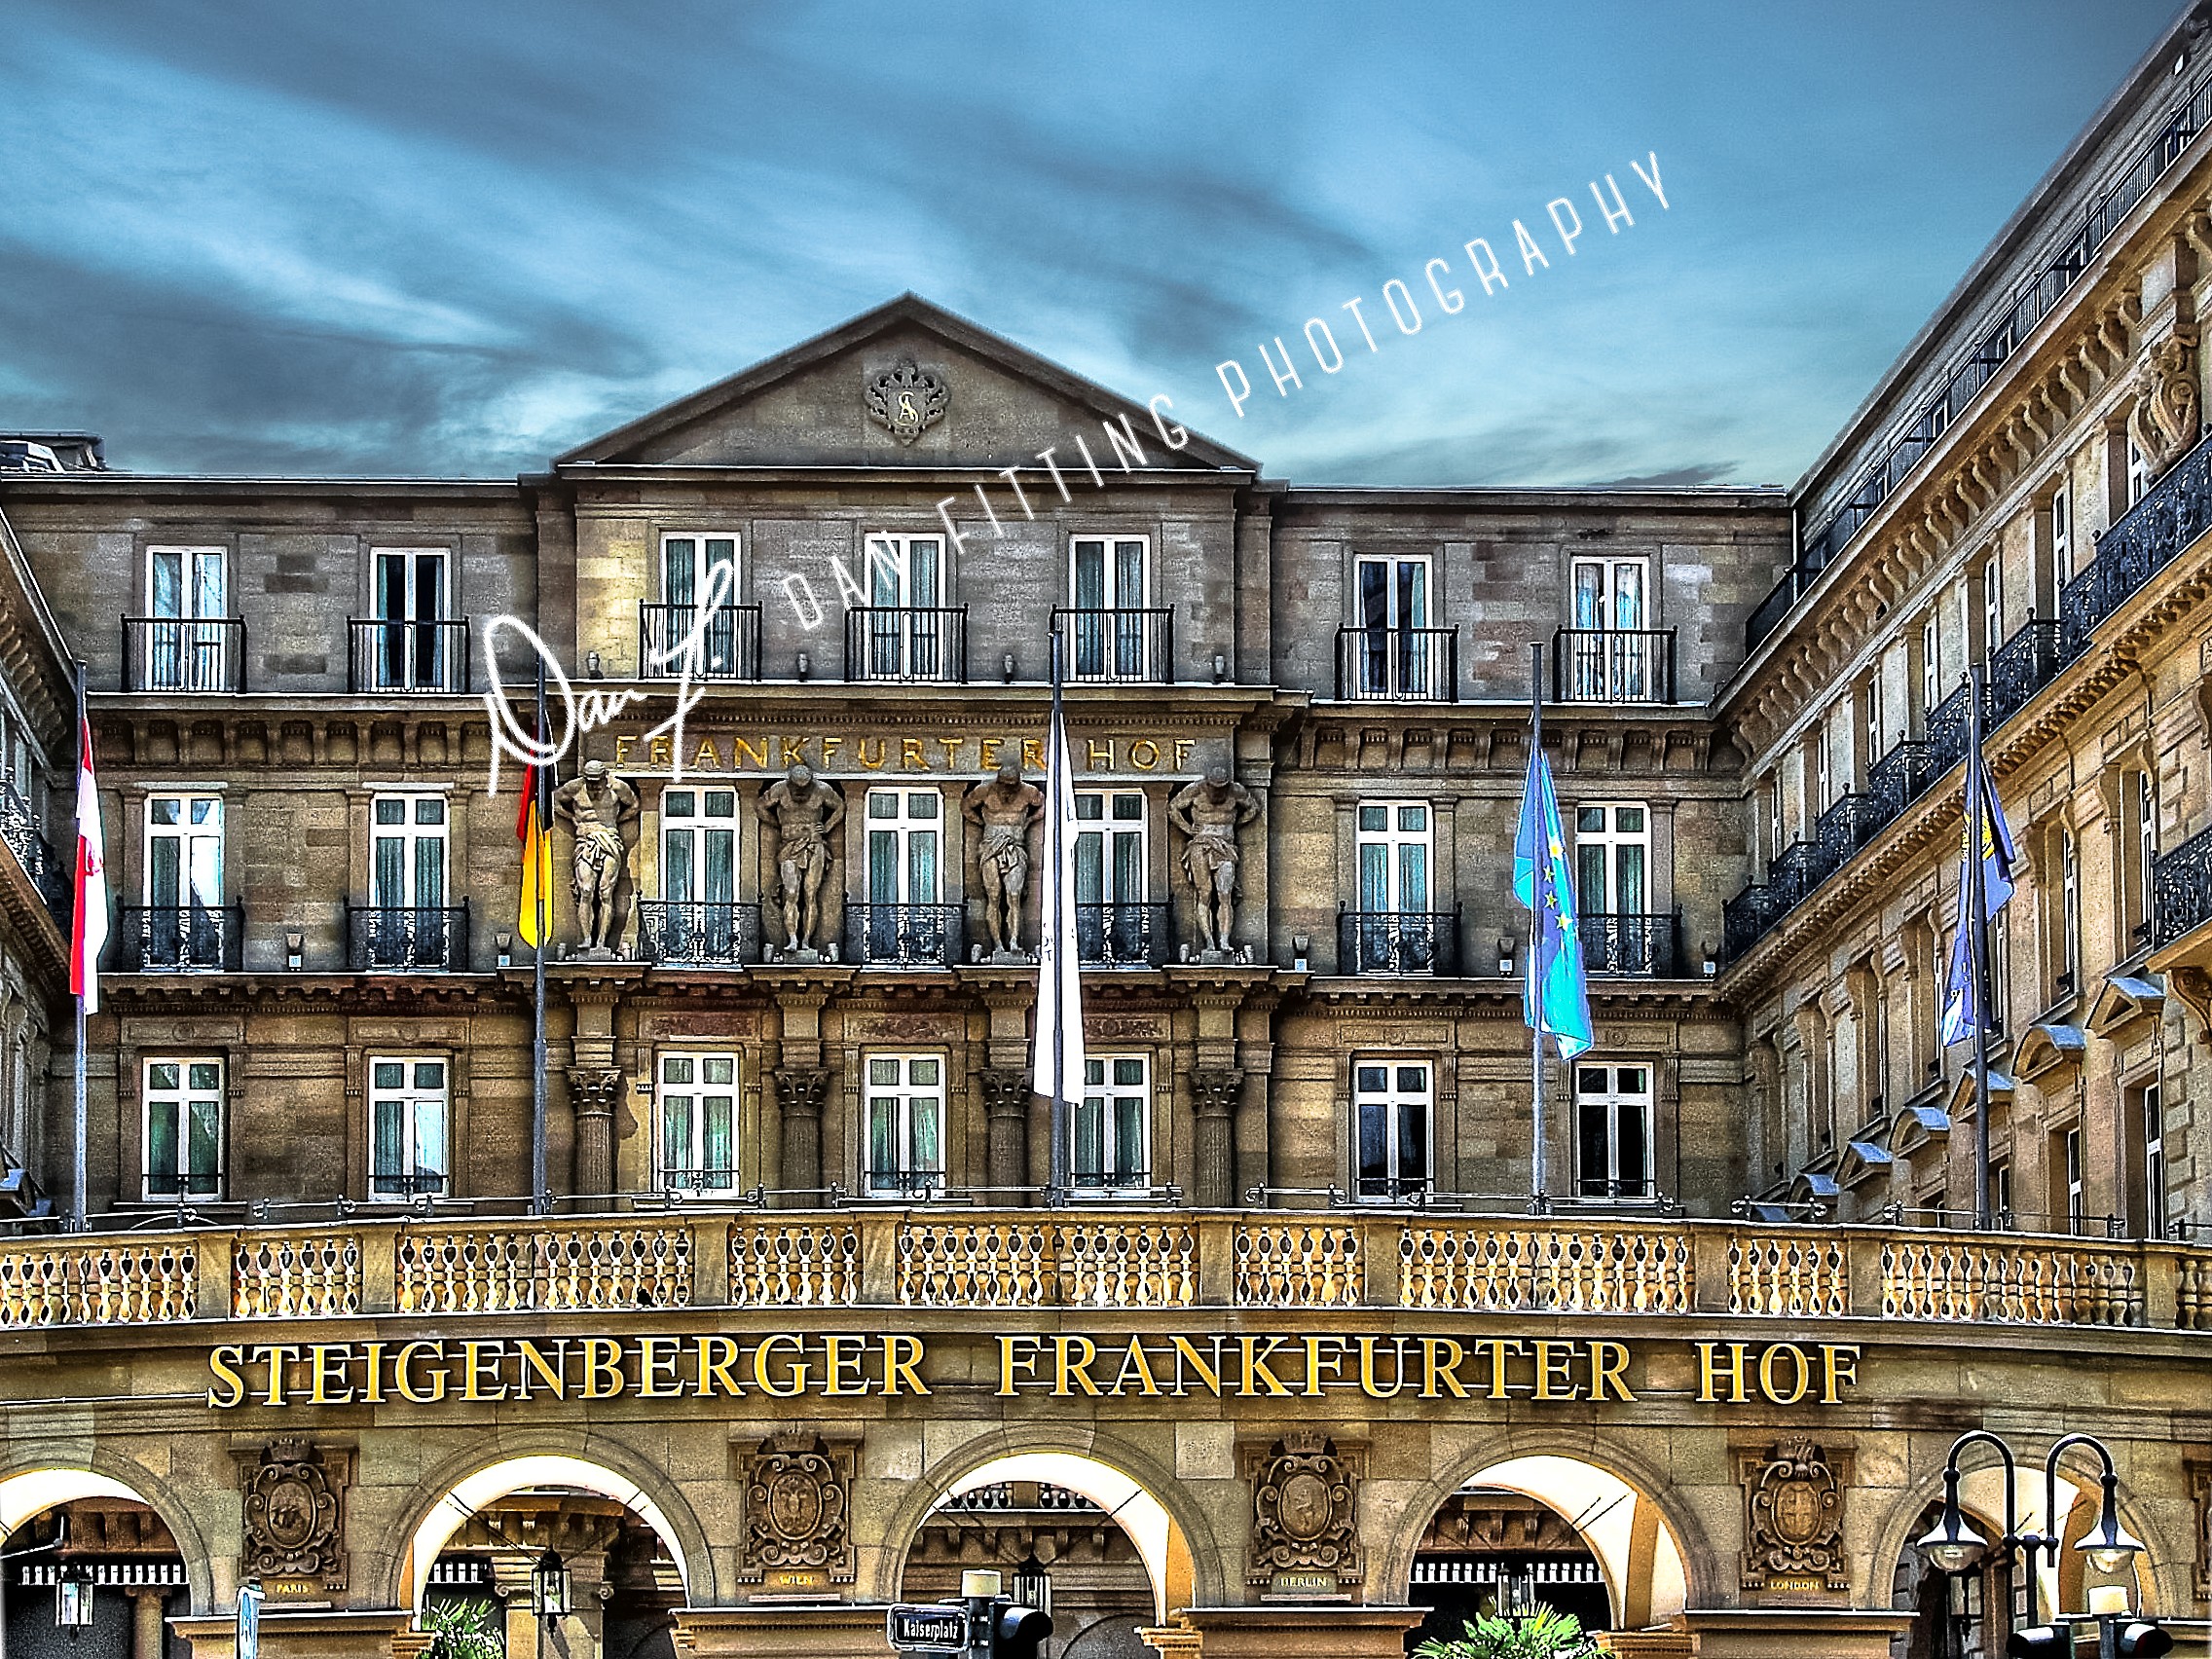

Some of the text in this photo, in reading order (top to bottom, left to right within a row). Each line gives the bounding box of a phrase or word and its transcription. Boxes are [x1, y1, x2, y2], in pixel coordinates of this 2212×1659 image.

[615, 735, 1197, 771] FRANKFURTER HOF
[206, 1335, 1862, 1408] STEIGENBERGER FRANKFURTER HOF
[779, 1575, 814, 1586] WIEN
[1280, 1576, 1327, 1587] BERLIN
[1770, 1580, 1819, 1591] LONDON
[276, 1583, 310, 1594] PARIS
[903, 1618, 959, 1642] Kaiserplatz
